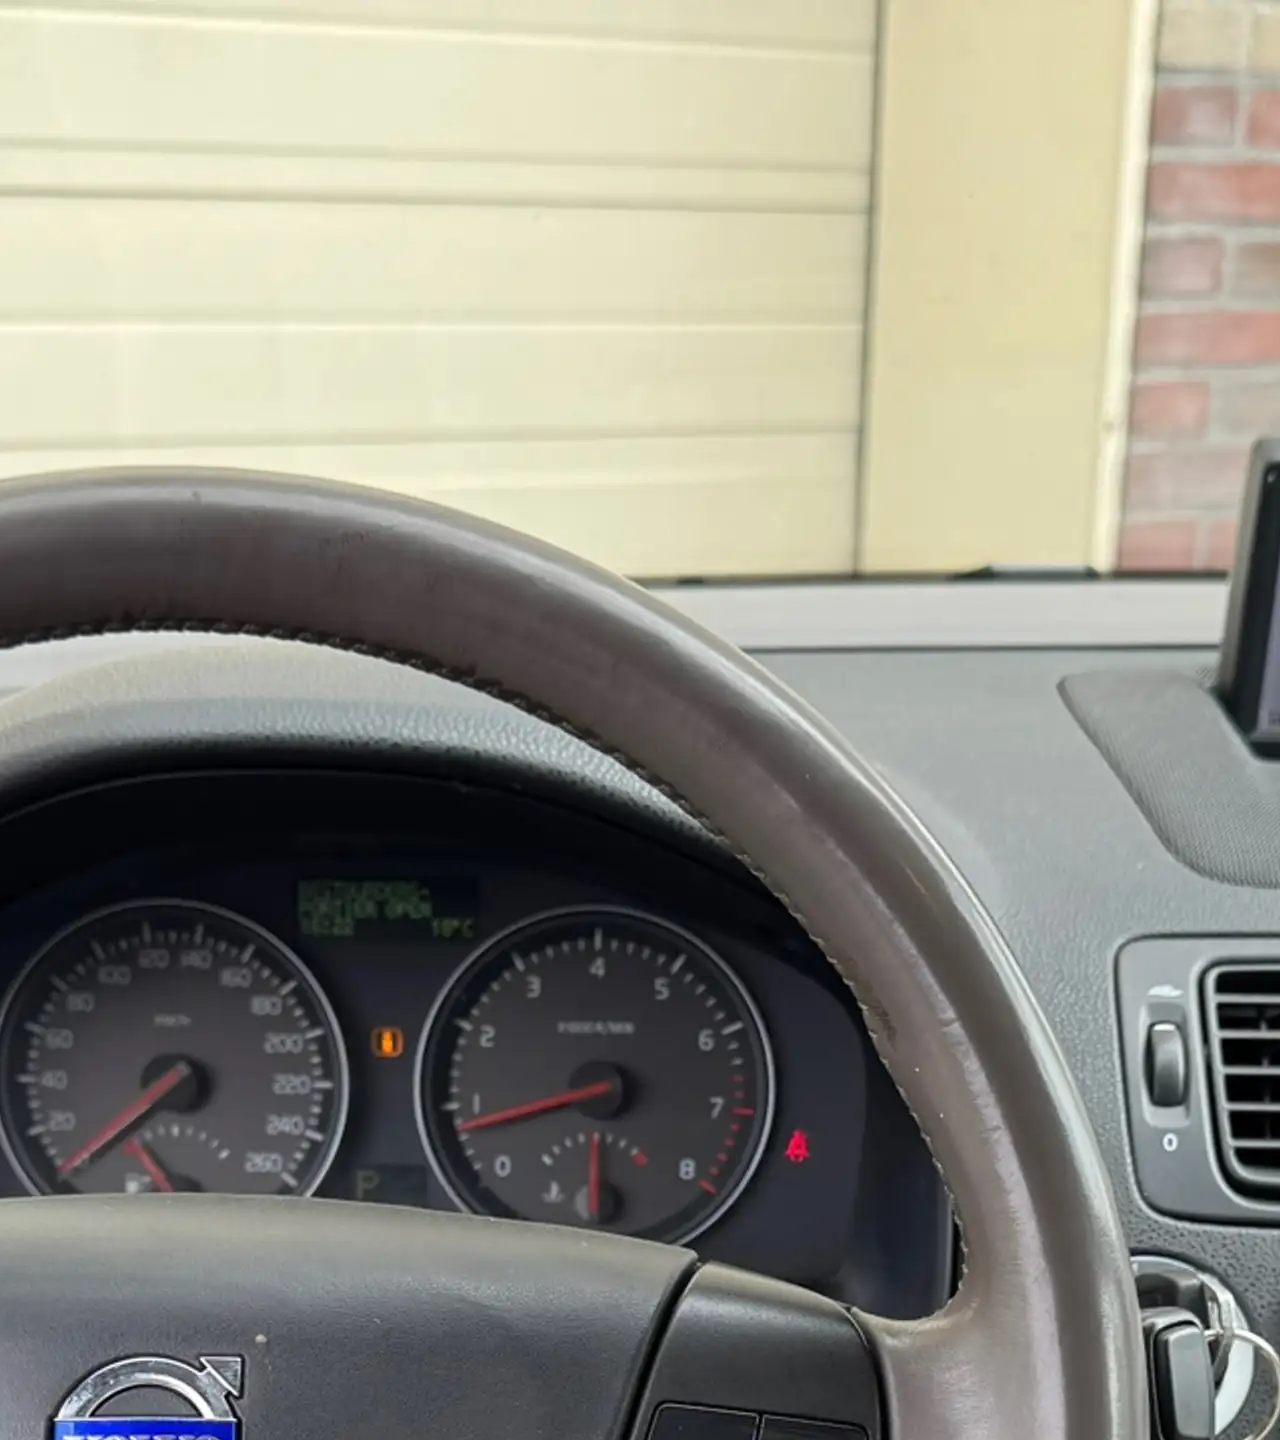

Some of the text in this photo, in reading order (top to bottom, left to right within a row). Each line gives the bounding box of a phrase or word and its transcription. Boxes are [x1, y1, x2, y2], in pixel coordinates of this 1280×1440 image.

[589, 956, 606, 979] 4
[526, 975, 543, 998] 3
[653, 977, 671, 1001] 5
[263, 1031, 305, 1054] 200
[478, 1024, 497, 1049] 2
[697, 1028, 715, 1052] 6
[272, 1073, 312, 1096] 220
[708, 1096, 725, 1120] 7
[265, 1114, 306, 1136] 240
[1162, 1132, 1179, 1152] 0
[493, 1154, 512, 1178] 0
[678, 1157, 697, 1181] 8
